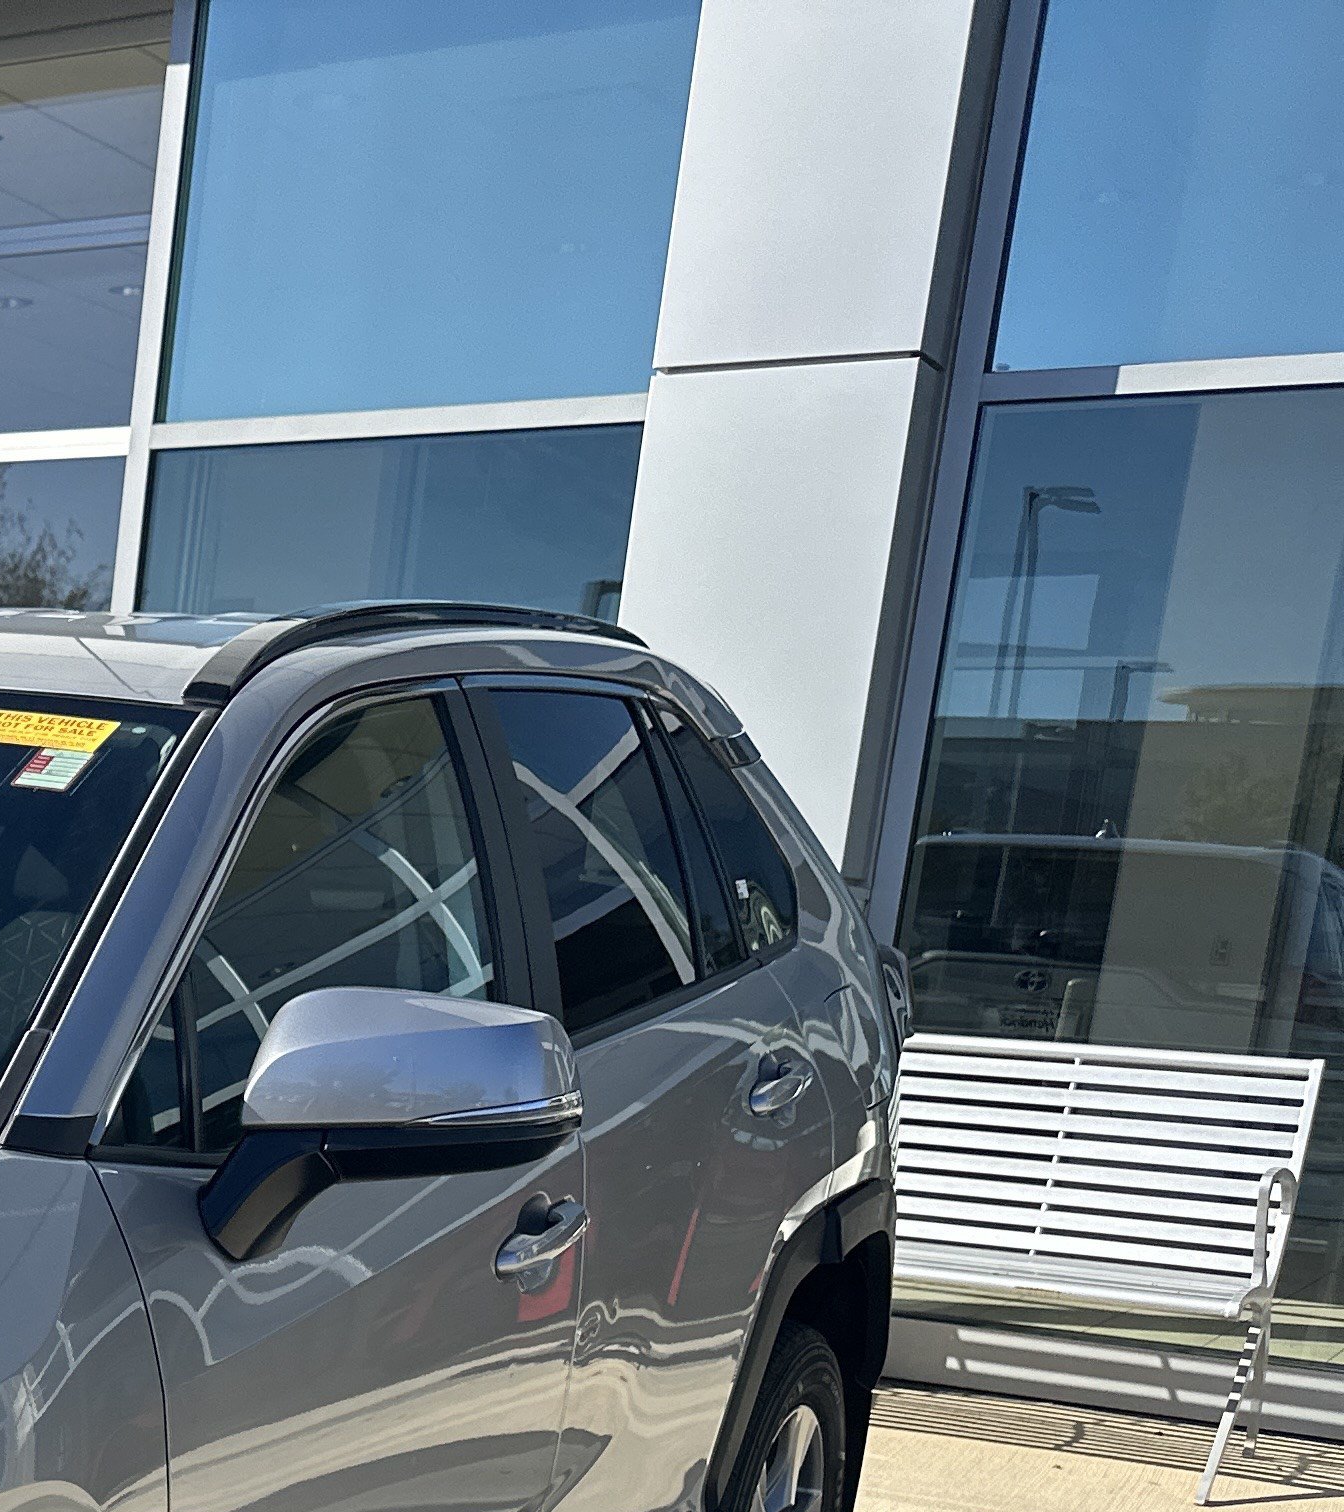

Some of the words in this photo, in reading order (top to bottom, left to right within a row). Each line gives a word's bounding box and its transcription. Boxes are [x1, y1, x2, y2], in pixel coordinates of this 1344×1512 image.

[23, 723, 55, 732] FOR
[58, 727, 97, 737] SALE
[38, 716, 108, 731] VEHICLE
